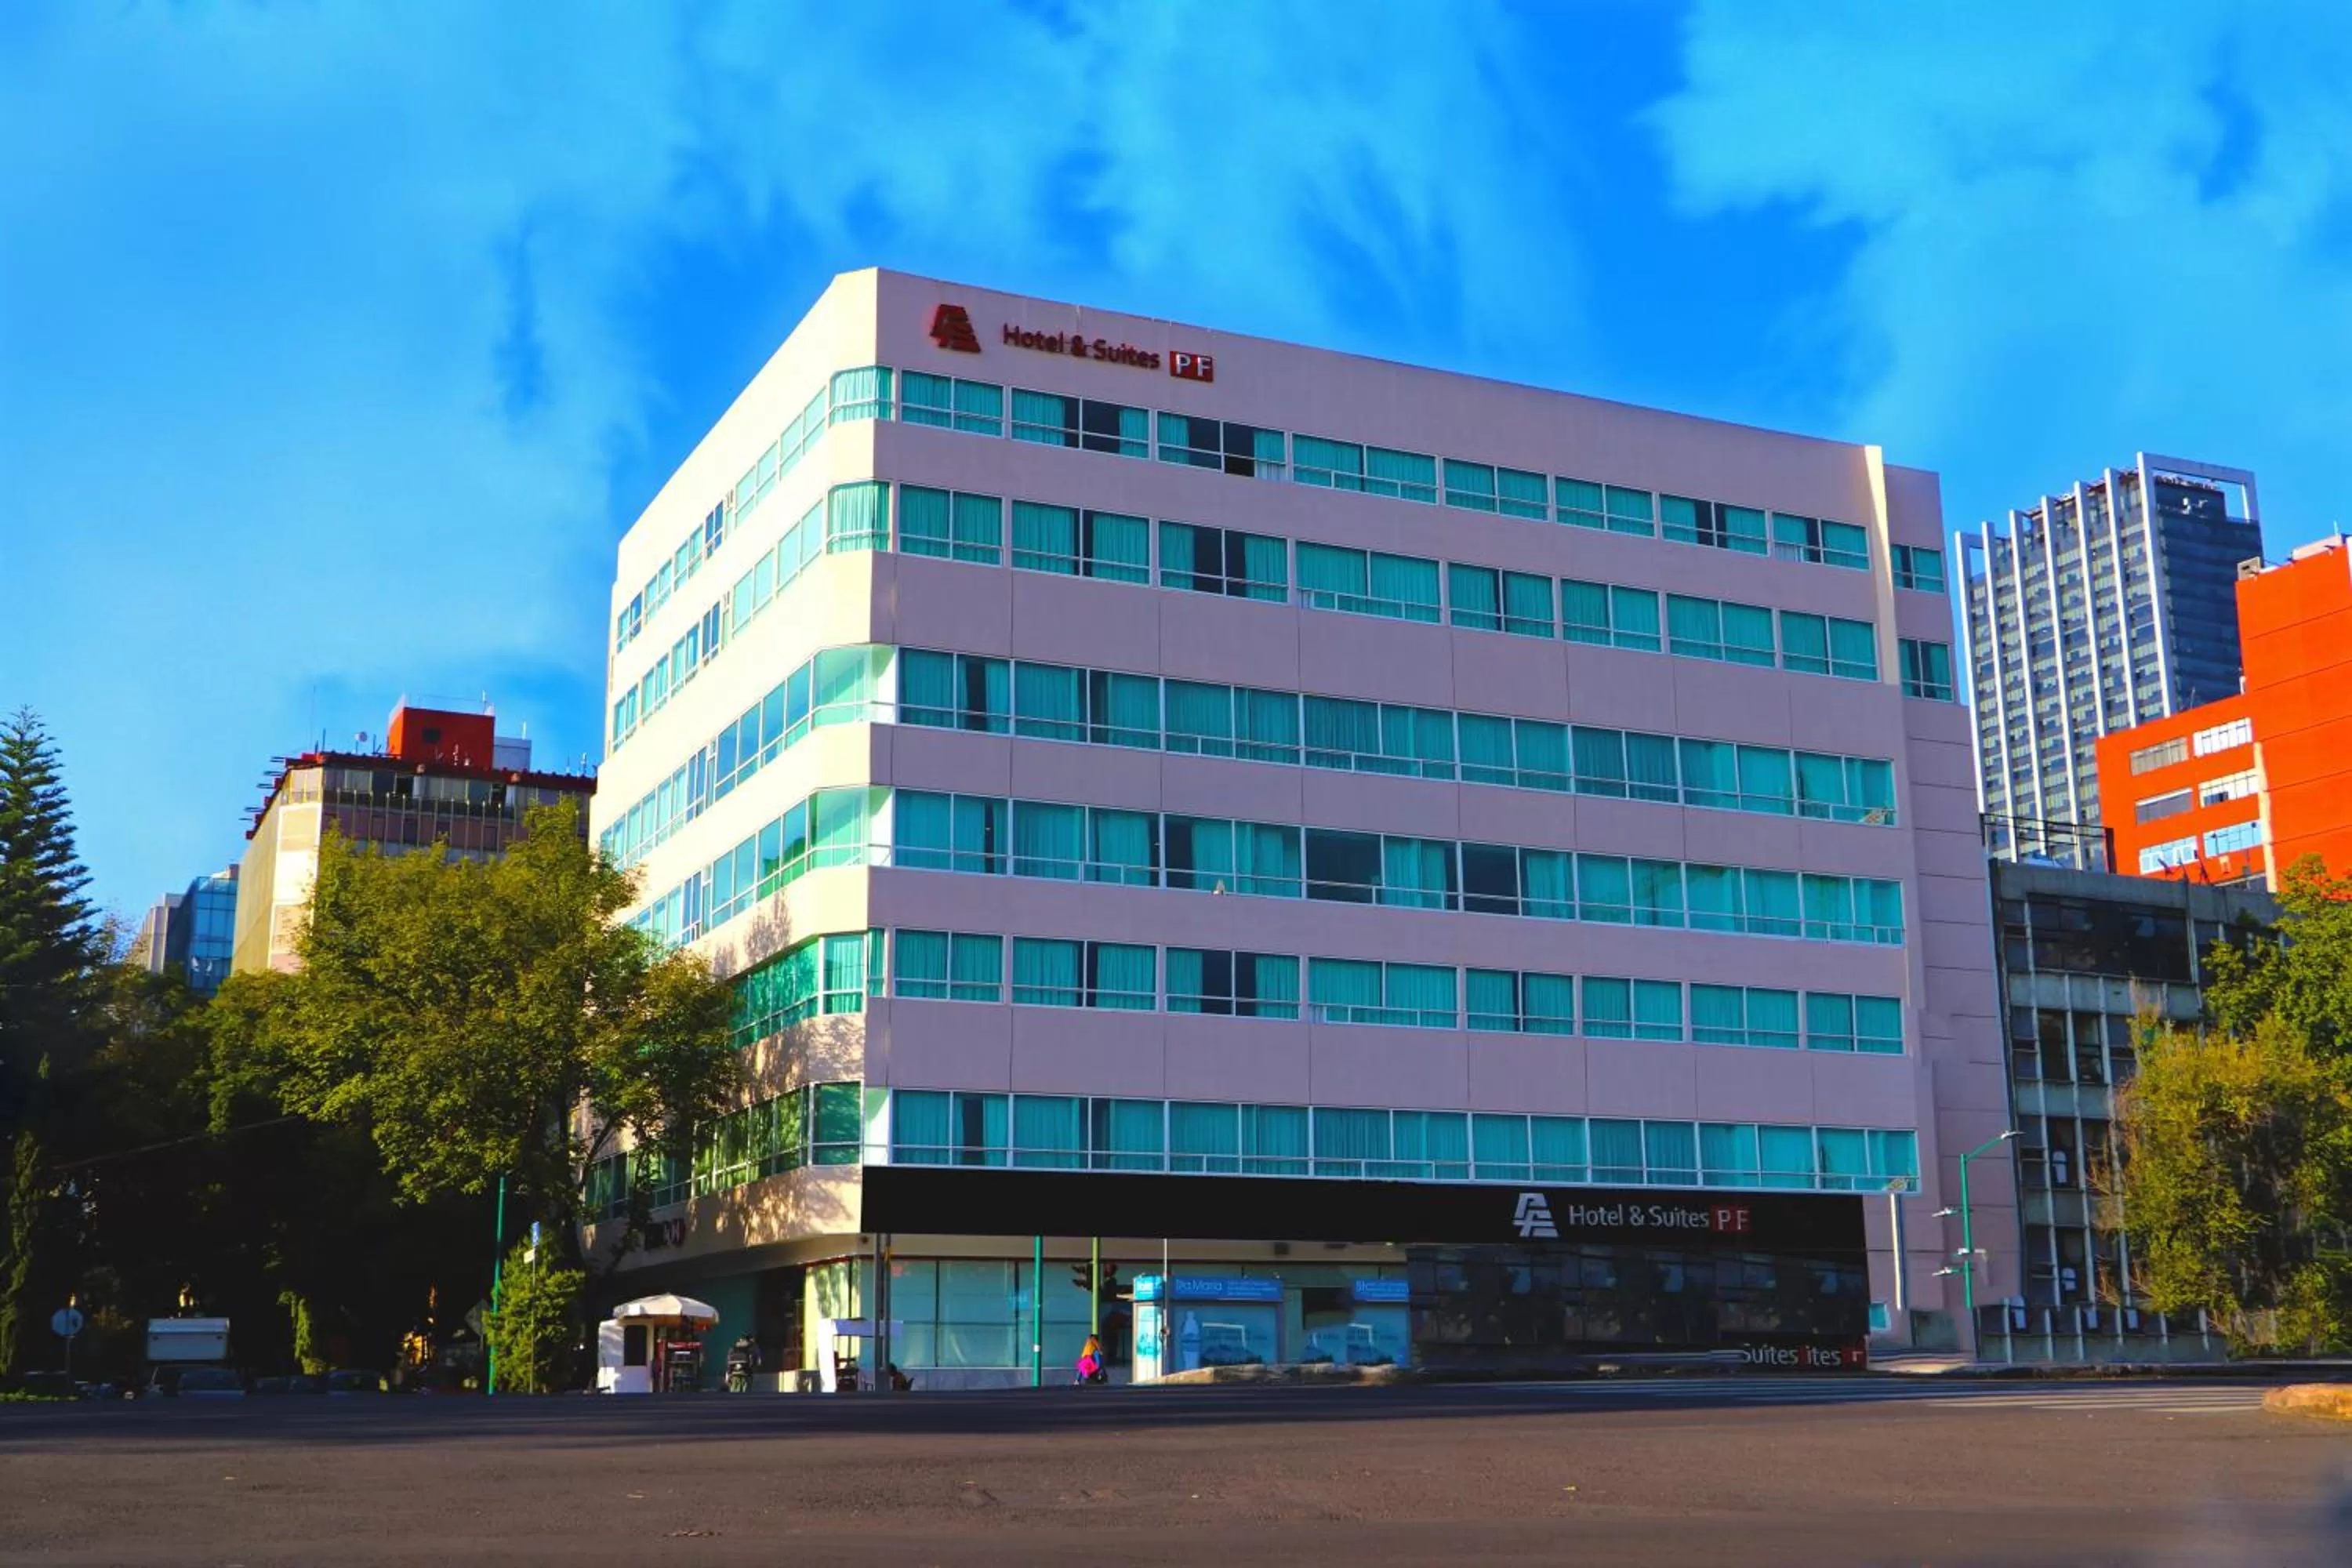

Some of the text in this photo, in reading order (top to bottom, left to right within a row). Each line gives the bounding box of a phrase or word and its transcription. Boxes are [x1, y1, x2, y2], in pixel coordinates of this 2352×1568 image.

[1003, 322, 1064, 354] Hotel
[1093, 338, 1161, 369] Suites
[1569, 1204, 1624, 1226] Hotel
[1629, 1205, 1646, 1226] &
[1648, 1205, 1710, 1229] Suites
